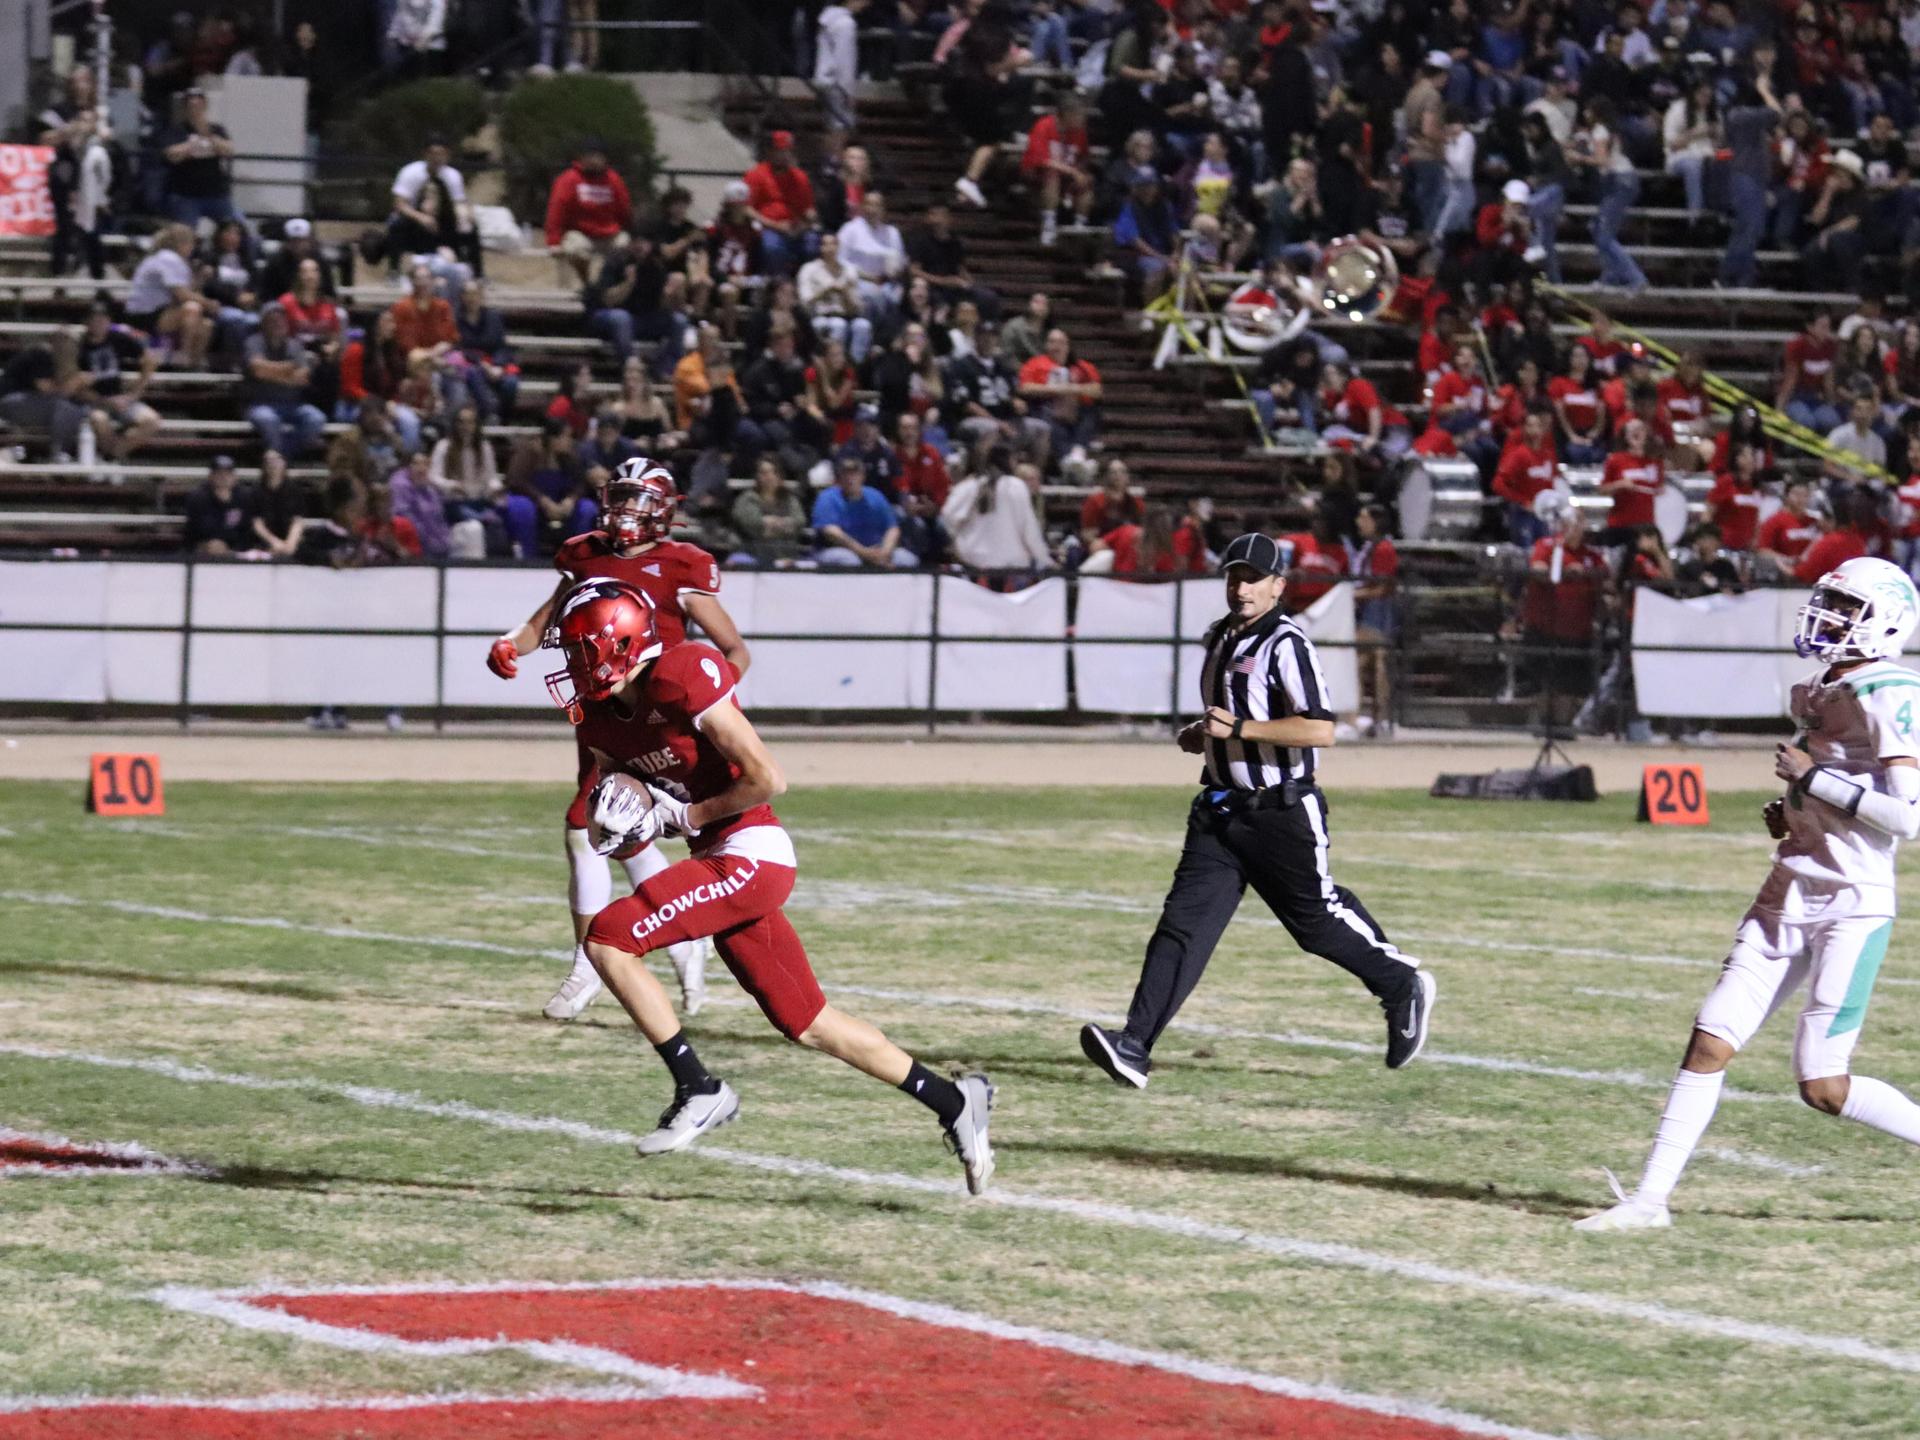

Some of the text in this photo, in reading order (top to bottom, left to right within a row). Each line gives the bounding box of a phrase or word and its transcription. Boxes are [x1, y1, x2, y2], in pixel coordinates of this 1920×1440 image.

[700, 658, 720, 689] 9
[1895, 700, 1913, 735] 4
[100, 756, 155, 805] 10
[1653, 768, 1700, 812] 20
